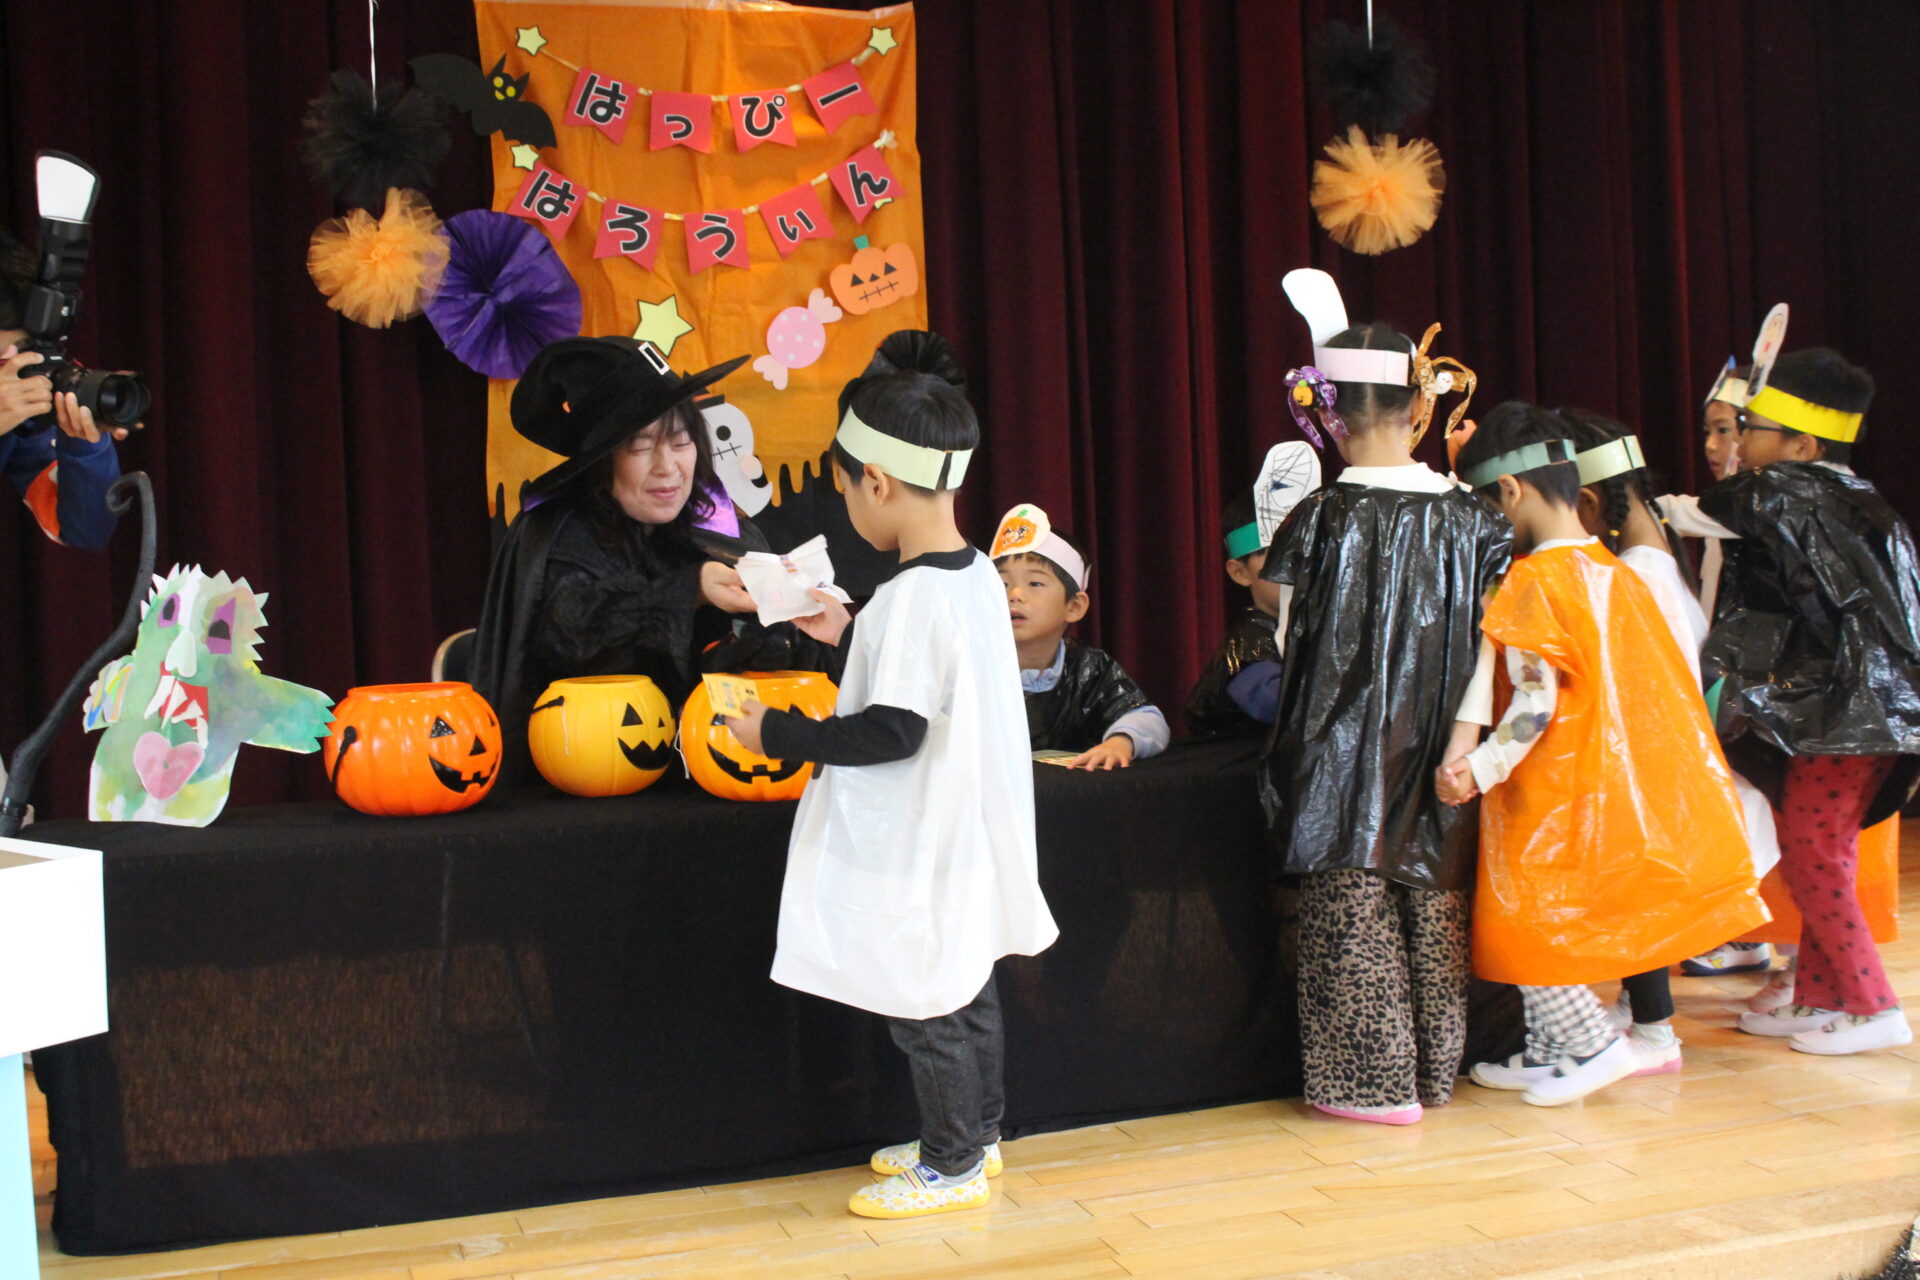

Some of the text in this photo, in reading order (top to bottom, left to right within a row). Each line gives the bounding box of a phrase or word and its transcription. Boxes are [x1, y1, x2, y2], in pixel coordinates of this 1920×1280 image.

[573, 72, 862, 140] はっぴー
[521, 161, 890, 260] はろうぃん
